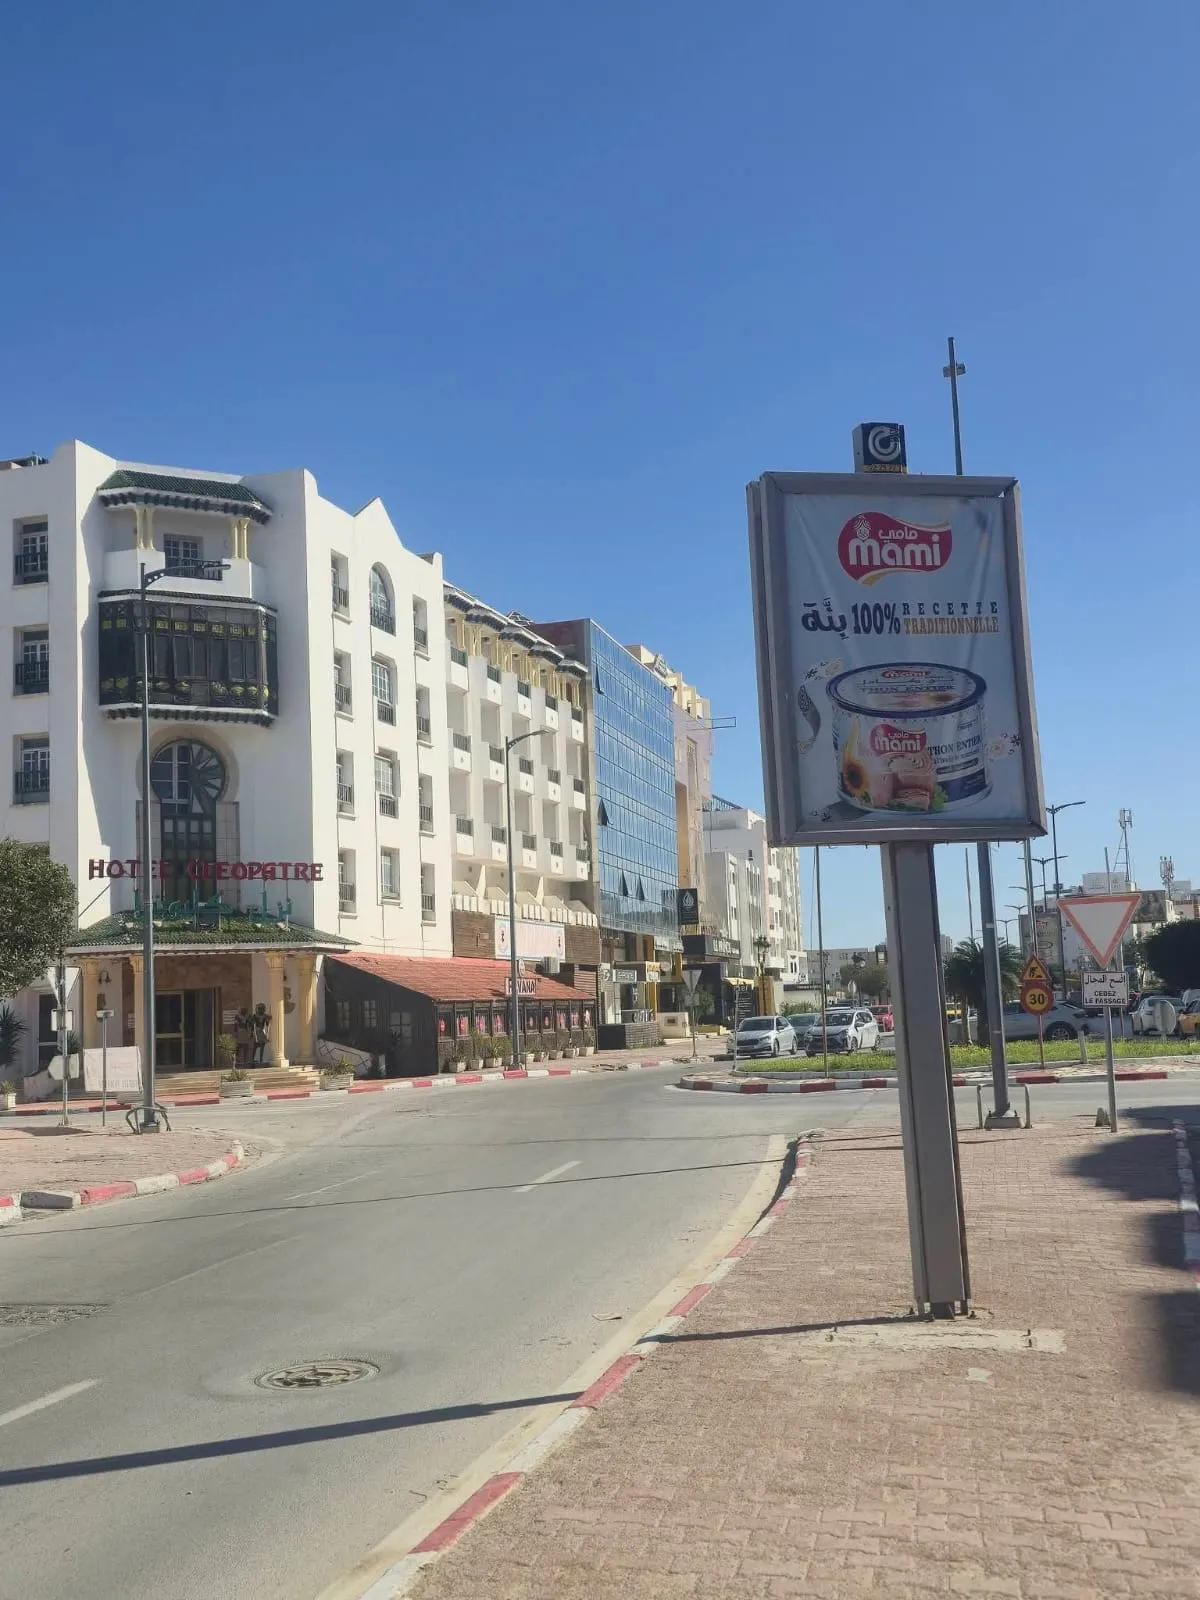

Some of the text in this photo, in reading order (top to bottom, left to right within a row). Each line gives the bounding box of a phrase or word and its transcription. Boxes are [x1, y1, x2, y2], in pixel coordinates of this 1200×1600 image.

[848, 534, 941, 566] mami
[852, 602, 900, 634] 100%
[902, 601, 998, 616] RECETTE
[904, 616, 1000, 635] TRADITIONNELLE
[186, 859, 323, 882] CLEOPATRE
[1029, 993, 1045, 1005] 30
